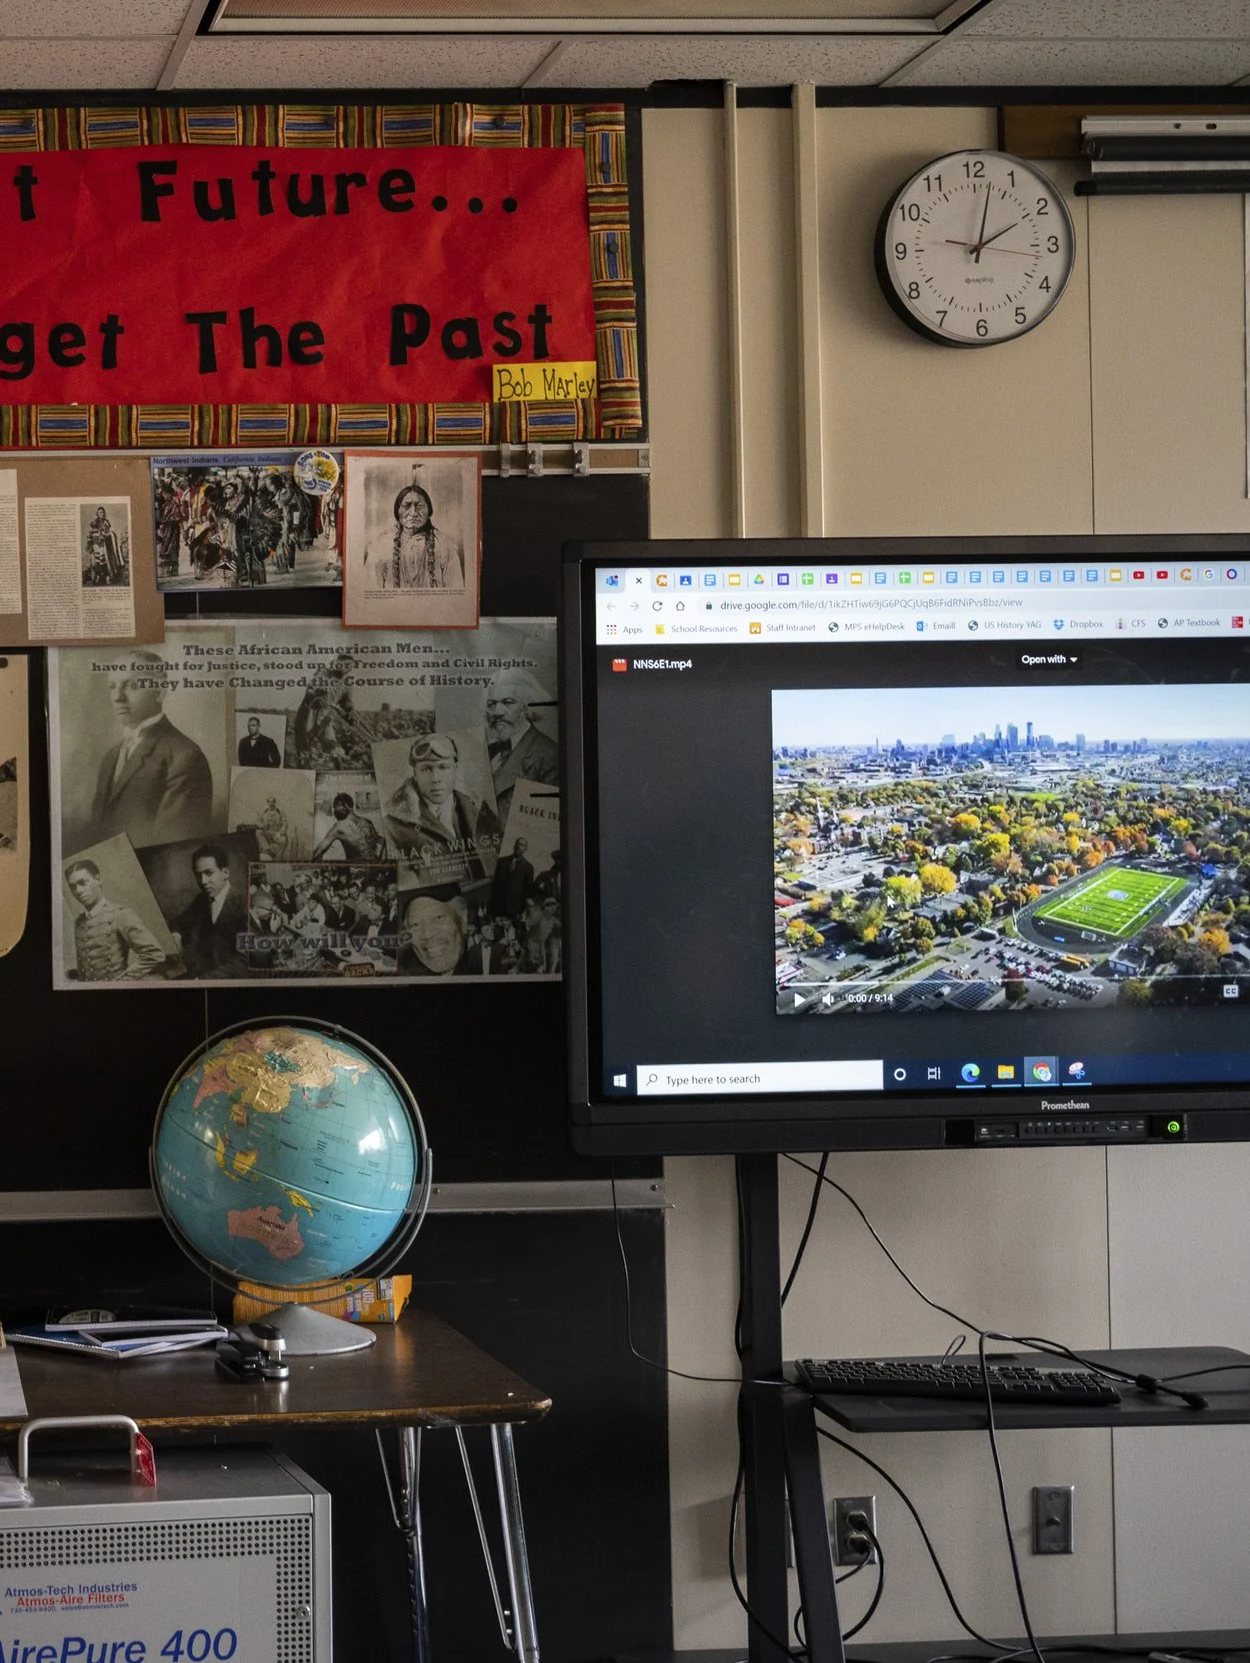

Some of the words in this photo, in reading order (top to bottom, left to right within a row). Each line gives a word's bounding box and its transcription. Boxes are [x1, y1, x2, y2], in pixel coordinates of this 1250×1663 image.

[962, 161, 985, 179] 12
[923, 175, 944, 192] 11
[1007, 170, 1016, 188] 1
[138, 160, 518, 222] Future...
[899, 204, 920, 221] 10
[1036, 198, 1049, 215] 2
[895, 243, 907, 260] 9
[1047, 236, 1059, 253] 3
[909, 282, 920, 300] 8
[1039, 276, 1051, 293] 4
[936, 311, 948, 328] 7
[1014, 307, 1027, 325] 5
[976, 319, 988, 337] 6
[186, 307, 326, 374] The
[389, 303, 554, 366] Past
[497, 367, 533, 400] Bob
[153, 457, 190, 465] Northwest
[192, 456, 219, 464] Indians
[623, 625, 643, 635] Apps
[671, 624, 696, 633] School
[699, 623, 738, 633] Resources
[766, 622, 783, 632] Staff
[785, 622, 816, 632] Intranet
[844, 622, 862, 631] MPS
[864, 621, 905, 632] eHelpDesk
[984, 621, 995, 630] US
[997, 620, 1024, 631] History
[1026, 620, 1042, 629] YAG
[1070, 619, 1104, 631] Dropbox
[1131, 619, 1146, 628] CFS
[1174, 618, 1183, 627] AP
[1185, 618, 1221, 628] Textbook
[183, 644, 234, 656] These
[238, 643, 301, 656] African
[306, 643, 393, 656] American
[396, 642, 451, 654] Men...
[92, 661, 127, 672] have
[129, 661, 180, 673] fought
[183, 661, 205, 671] for
[207, 661, 261, 672] Justice,
[263, 660, 303, 671] stood
[307, 662, 326, 673] up
[353, 658, 419, 669] Freedom
[422, 658, 450, 669] and
[453, 658, 485, 668] Civil
[488, 657, 538, 670] Rights.
[633, 658, 693, 671] NNS6E1.mp4
[1021, 655, 1045, 666] Open
[1047, 654, 1066, 664] with
[138, 678, 179, 691] They
[183, 677, 224, 688] have
[228, 676, 307, 690] Changed
[312, 675, 339, 687] the
[344, 674, 405, 687] Course
[408, 674, 426, 686] of
[430, 674, 496, 689] History.
[519, 804, 545, 817] BLACK
[447, 833, 500, 852] WINGS
[236, 932, 294, 950] How
[300, 930, 348, 949] will
[350, 931, 413, 952] you?
[848, 994, 866, 1003] 0:00
[875, 993, 893, 1003] 9:14
[666, 1075, 689, 1087] Type
[692, 1075, 713, 1084] here
[716, 1075, 726, 1084] to
[729, 1074, 761, 1083] search
[1041, 1100, 1090, 1110] Promethean
[258, 1216, 286, 1231] Australia
[4, 1585, 74, 1597] Atmos-Tech
[78, 1582, 137, 1594] Industries
[16, 1595, 84, 1607] Atmos-Aire
[88, 1593, 125, 1603] Filters
[160, 1627, 238, 1663] 400
